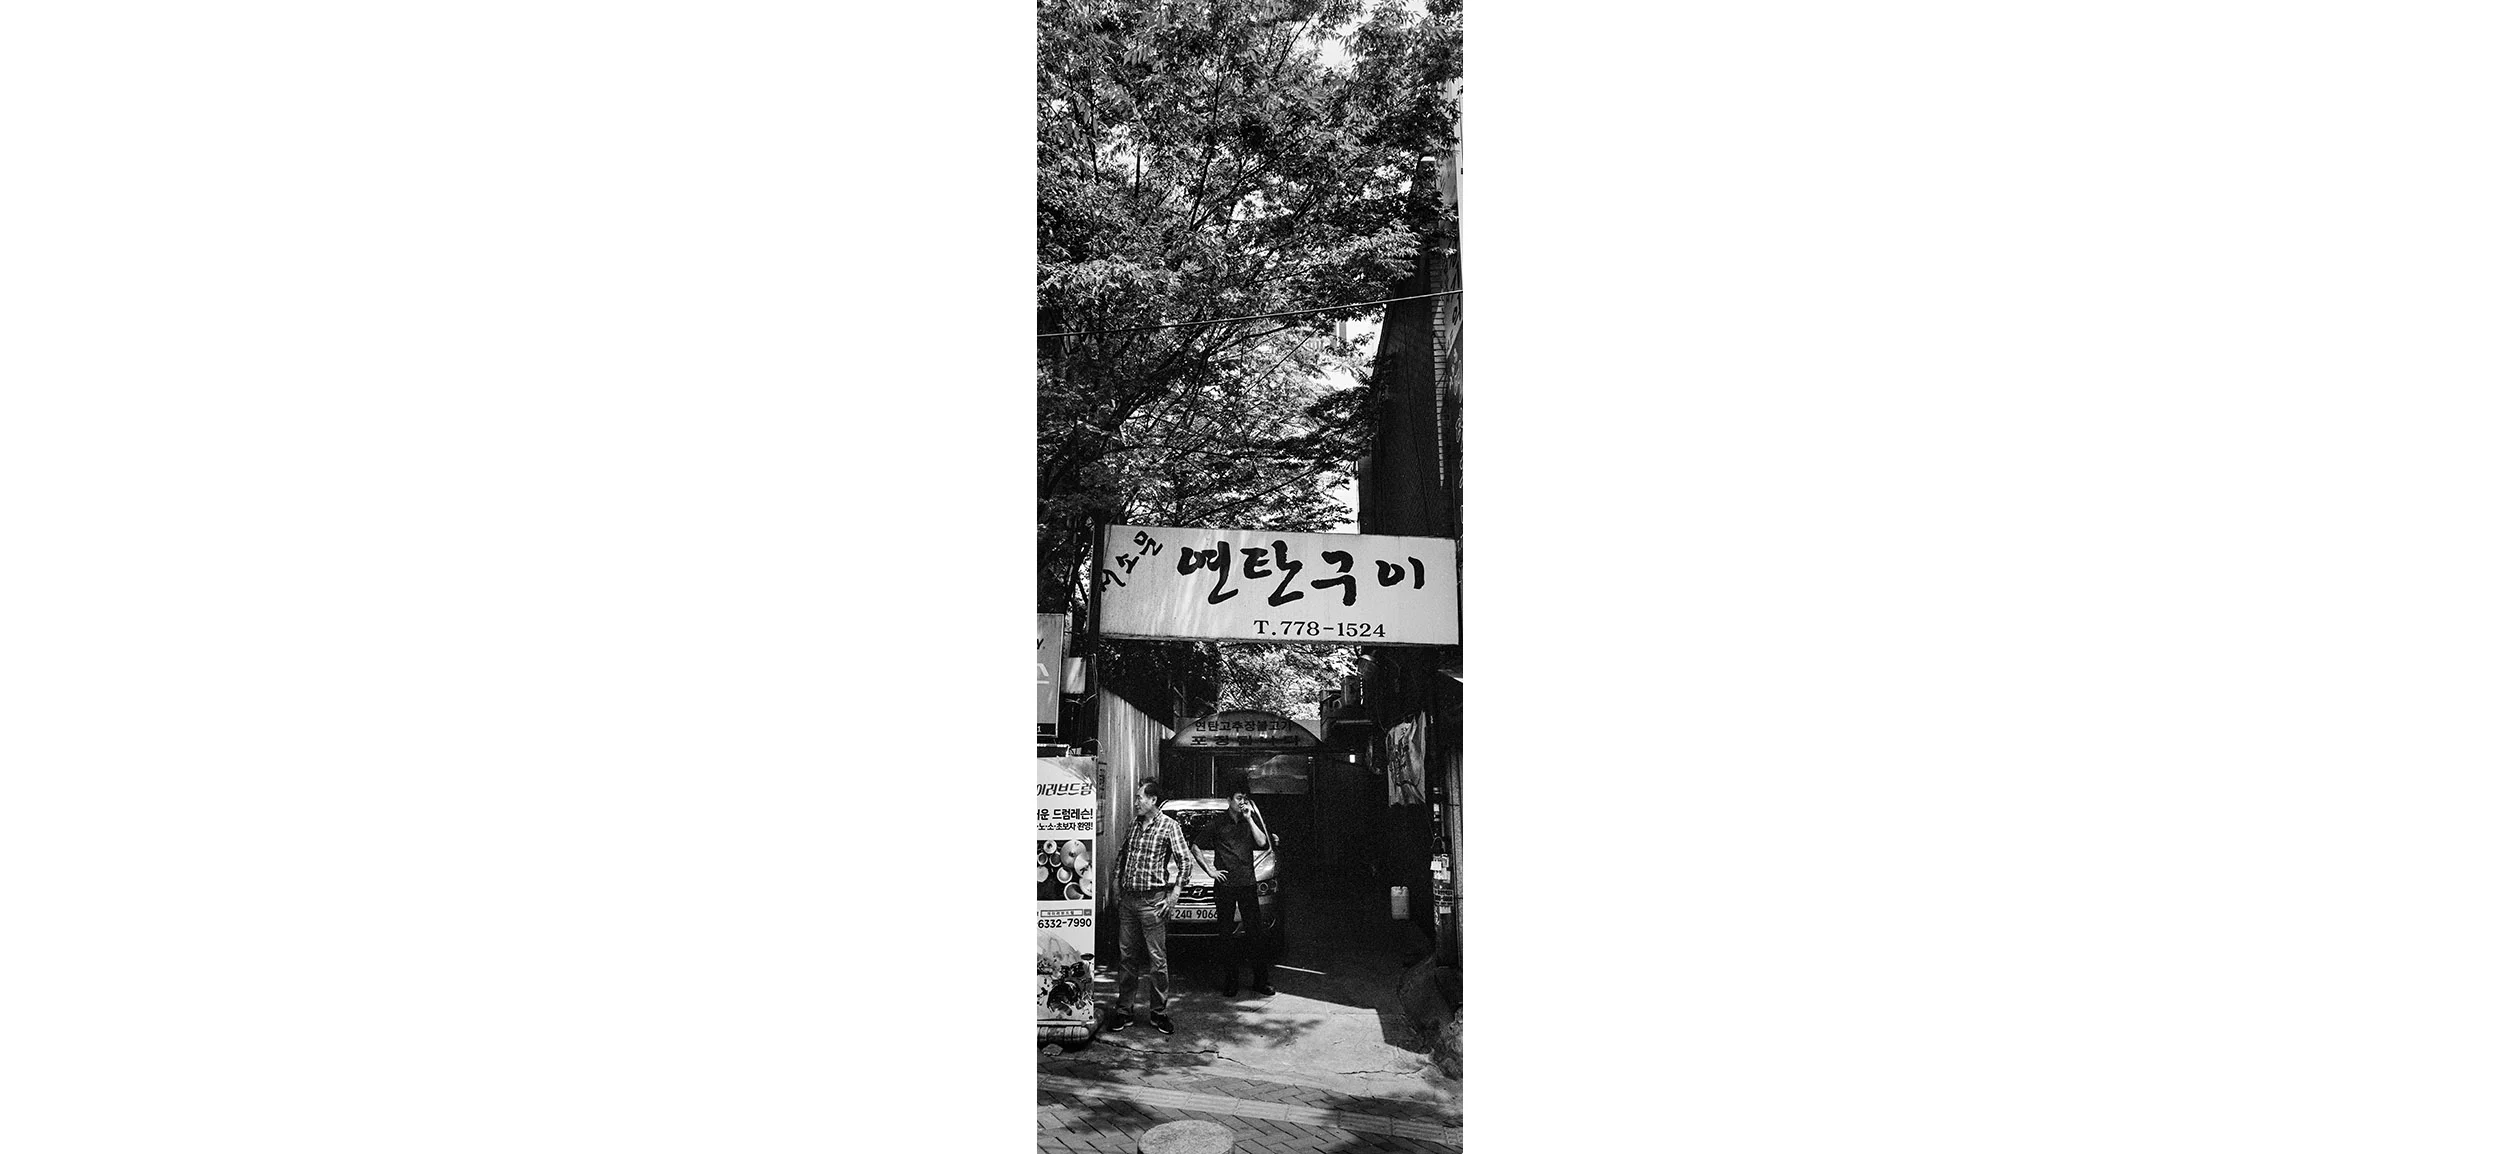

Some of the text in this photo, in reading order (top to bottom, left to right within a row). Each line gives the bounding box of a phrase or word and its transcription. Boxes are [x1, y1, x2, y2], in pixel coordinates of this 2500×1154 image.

[1176, 540, 1425, 608] 연탄구이
[1052, 807, 1093, 821] 드럼레슨!
[1077, 821, 1094, 832] 환영!
[1037, 917, 1092, 929] 6332-7990
